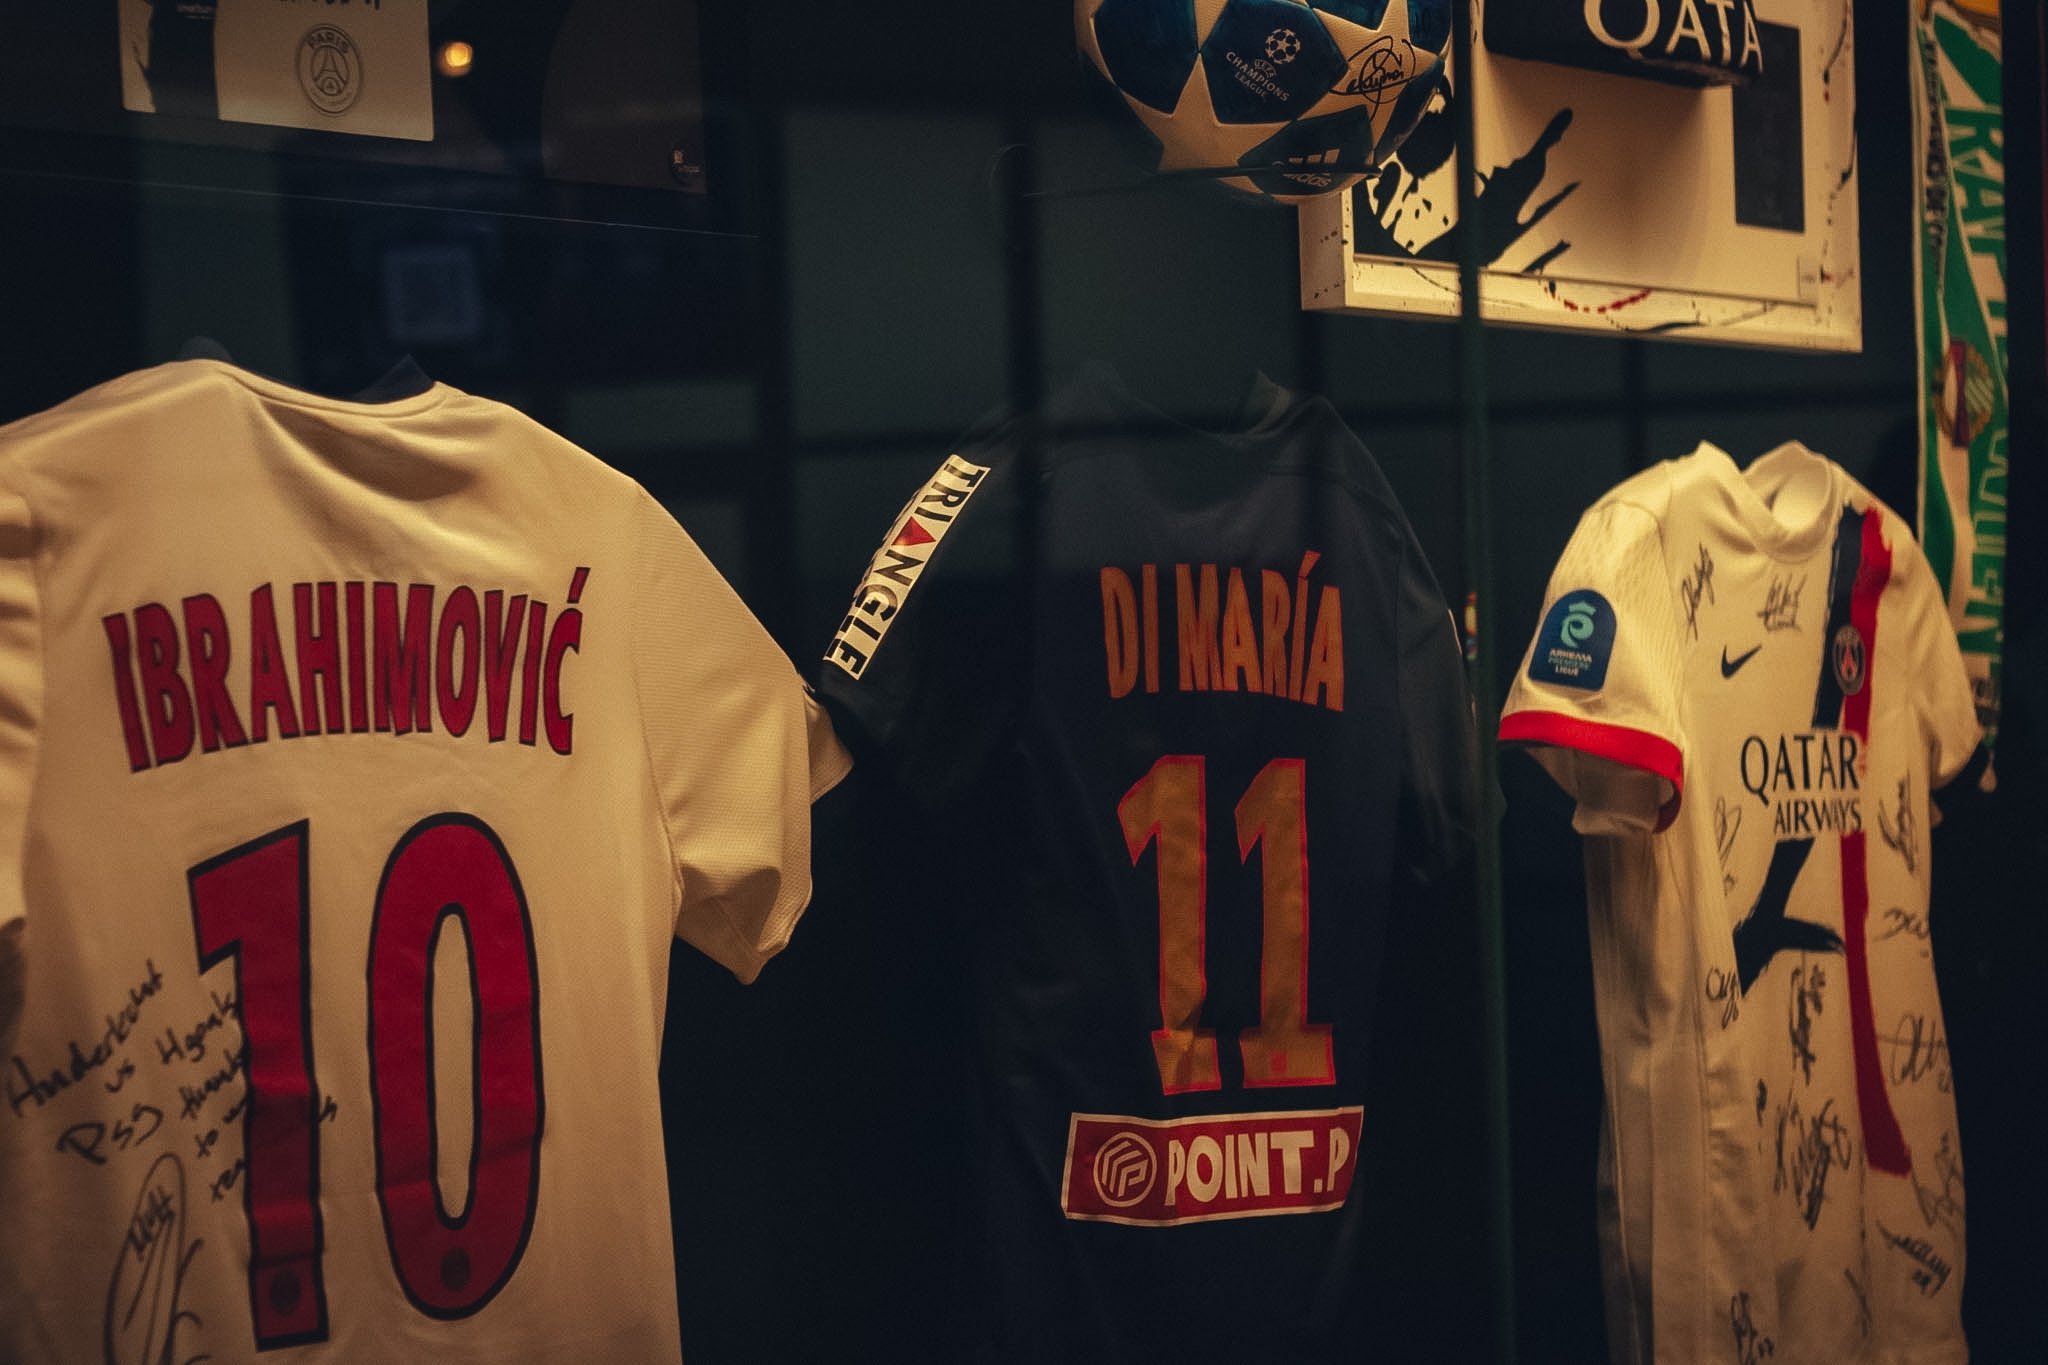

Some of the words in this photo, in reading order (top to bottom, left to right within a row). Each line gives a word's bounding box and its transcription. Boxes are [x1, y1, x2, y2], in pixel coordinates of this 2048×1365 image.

[1225, 51, 1291, 102] CHAMPIONS
[1234, 72, 1269, 98] LEAGUE
[1254, 58, 1277, 80] UEFA
[103, 567, 591, 773] IBRAHIMOVIĆ
[1101, 563, 1159, 698] DI
[1176, 550, 1345, 712] MARÍA
[1740, 734, 1860, 807] QATAR
[1117, 755, 1337, 1096] 11
[187, 812, 546, 1353] 10
[1164, 1127, 1351, 1206] POINT.P
